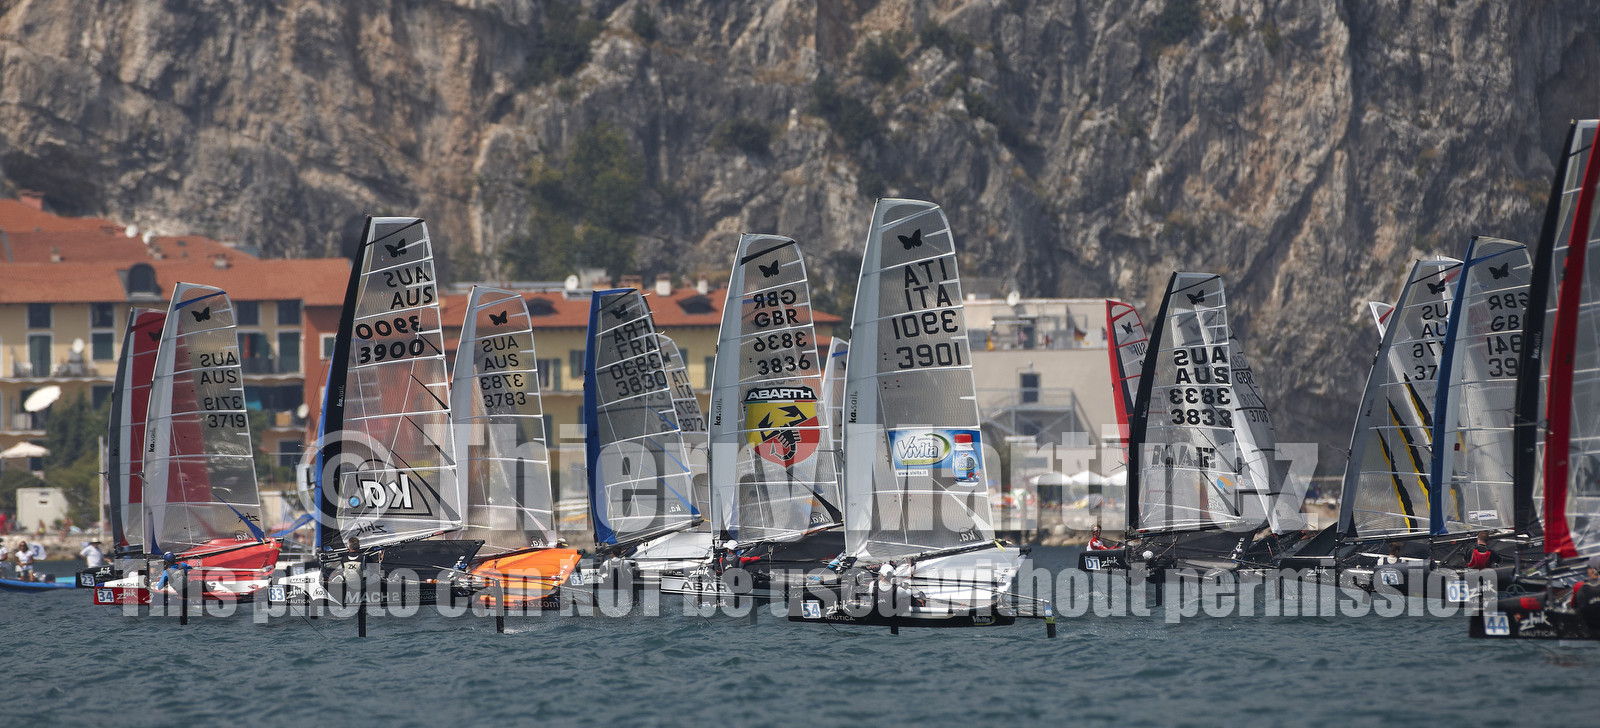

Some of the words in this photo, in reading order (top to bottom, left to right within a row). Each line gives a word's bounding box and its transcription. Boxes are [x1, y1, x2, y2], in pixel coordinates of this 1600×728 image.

[390, 287, 433, 310] AUS
[904, 284, 953, 311] ITA
[754, 308, 799, 328] GBR
[1491, 315, 1522, 332] GB
[1421, 321, 1448, 339] AU
[360, 339, 425, 364] 3900
[617, 336, 656, 360] FRA
[896, 342, 962, 369] 3901
[484, 353, 519, 371] AUS
[757, 354, 811, 376] 3836
[200, 370, 237, 385] AUS
[1176, 366, 1230, 385] AUS
[1235, 371, 1254, 385] GBR
[615, 370, 667, 397] 3830
[676, 384, 695, 399] ITA
[747, 388, 812, 400] ABARTH
[484, 391, 527, 408] 3783
[208, 414, 246, 428] 3719
[1171, 409, 1232, 427] 3833
[1249, 410, 1269, 423] 3708
[679, 417, 706, 432] 3872
[896, 435, 939, 459] Vivita
[1086, 558, 1099, 569] D1
[1101, 556, 1120, 568] zhik
[96, 566, 112, 578] zhik
[689, 567, 712, 579] zhik
[1306, 566, 1330, 577] zhik
[1382, 573, 1398, 584] 43
[82, 575, 95, 586] 23
[571, 575, 583, 585] 63
[98, 591, 114, 602] 34
[116, 588, 138, 600] zhik
[270, 588, 284, 600] 83
[345, 591, 390, 604] MACH
[392, 591, 400, 602] 2
[1448, 584, 1469, 601] 05
[802, 603, 821, 618] 54
[826, 599, 852, 616] zhik
[1486, 616, 1508, 633] 44
[1520, 611, 1553, 631] zhik
